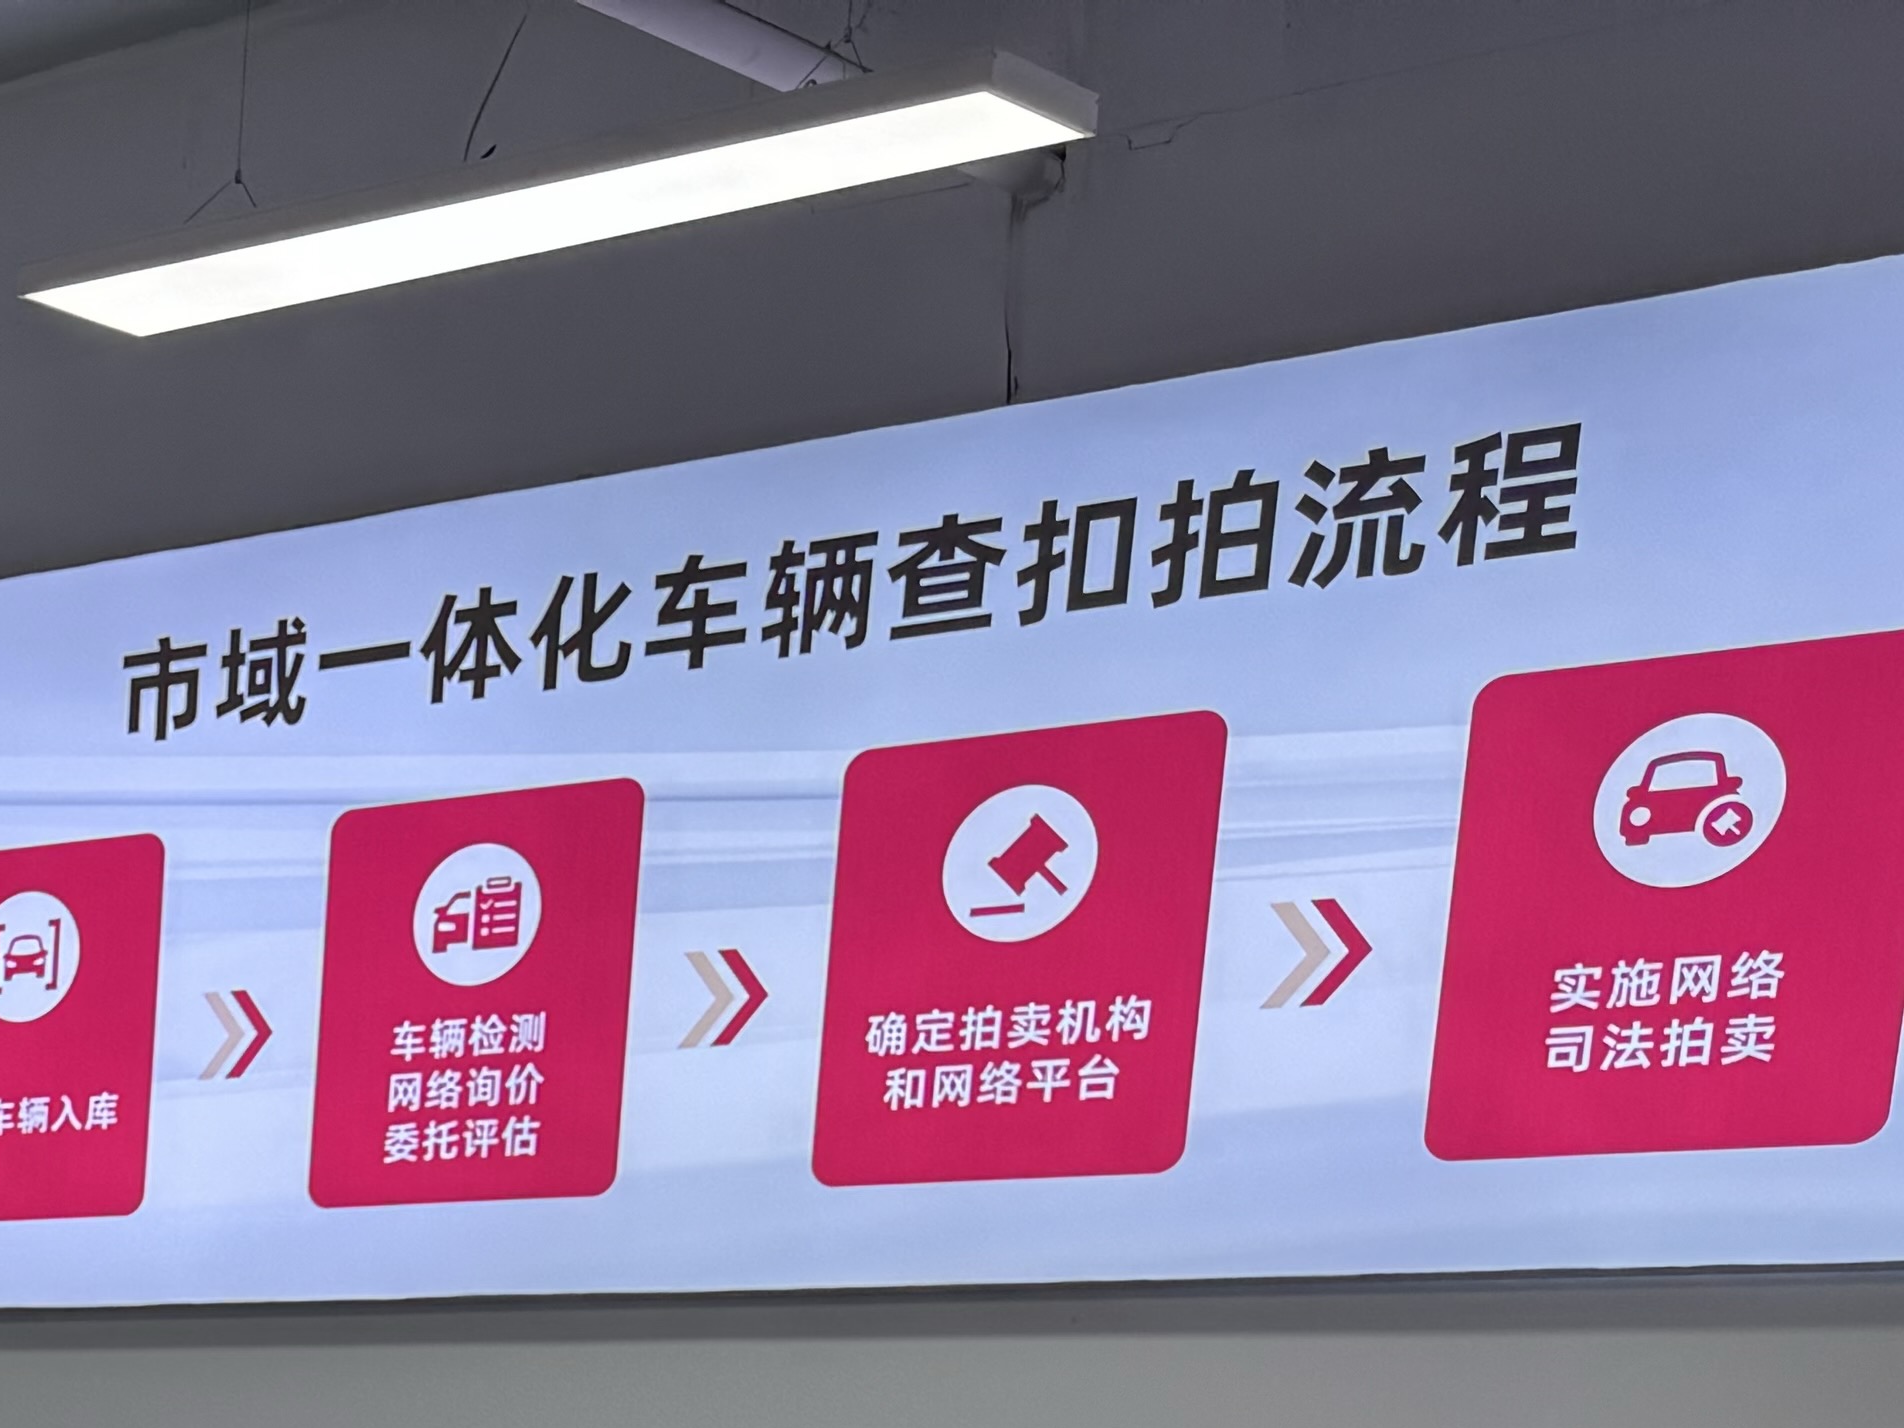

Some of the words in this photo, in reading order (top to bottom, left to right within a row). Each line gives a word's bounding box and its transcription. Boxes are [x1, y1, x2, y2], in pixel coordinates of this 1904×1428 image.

[121, 422, 1582, 740] 市域一体化车辆查扣拍流程
[1549, 949, 1785, 1013] 实施网络
[390, 1011, 546, 1062] 车辆检测
[865, 994, 1152, 1057] 确定拍卖机构
[1545, 1013, 1776, 1072] 司法拍卖
[387, 1062, 545, 1112] 网络询价
[883, 1053, 1120, 1111] 和网络平台
[383, 1115, 541, 1164] 委托评估
